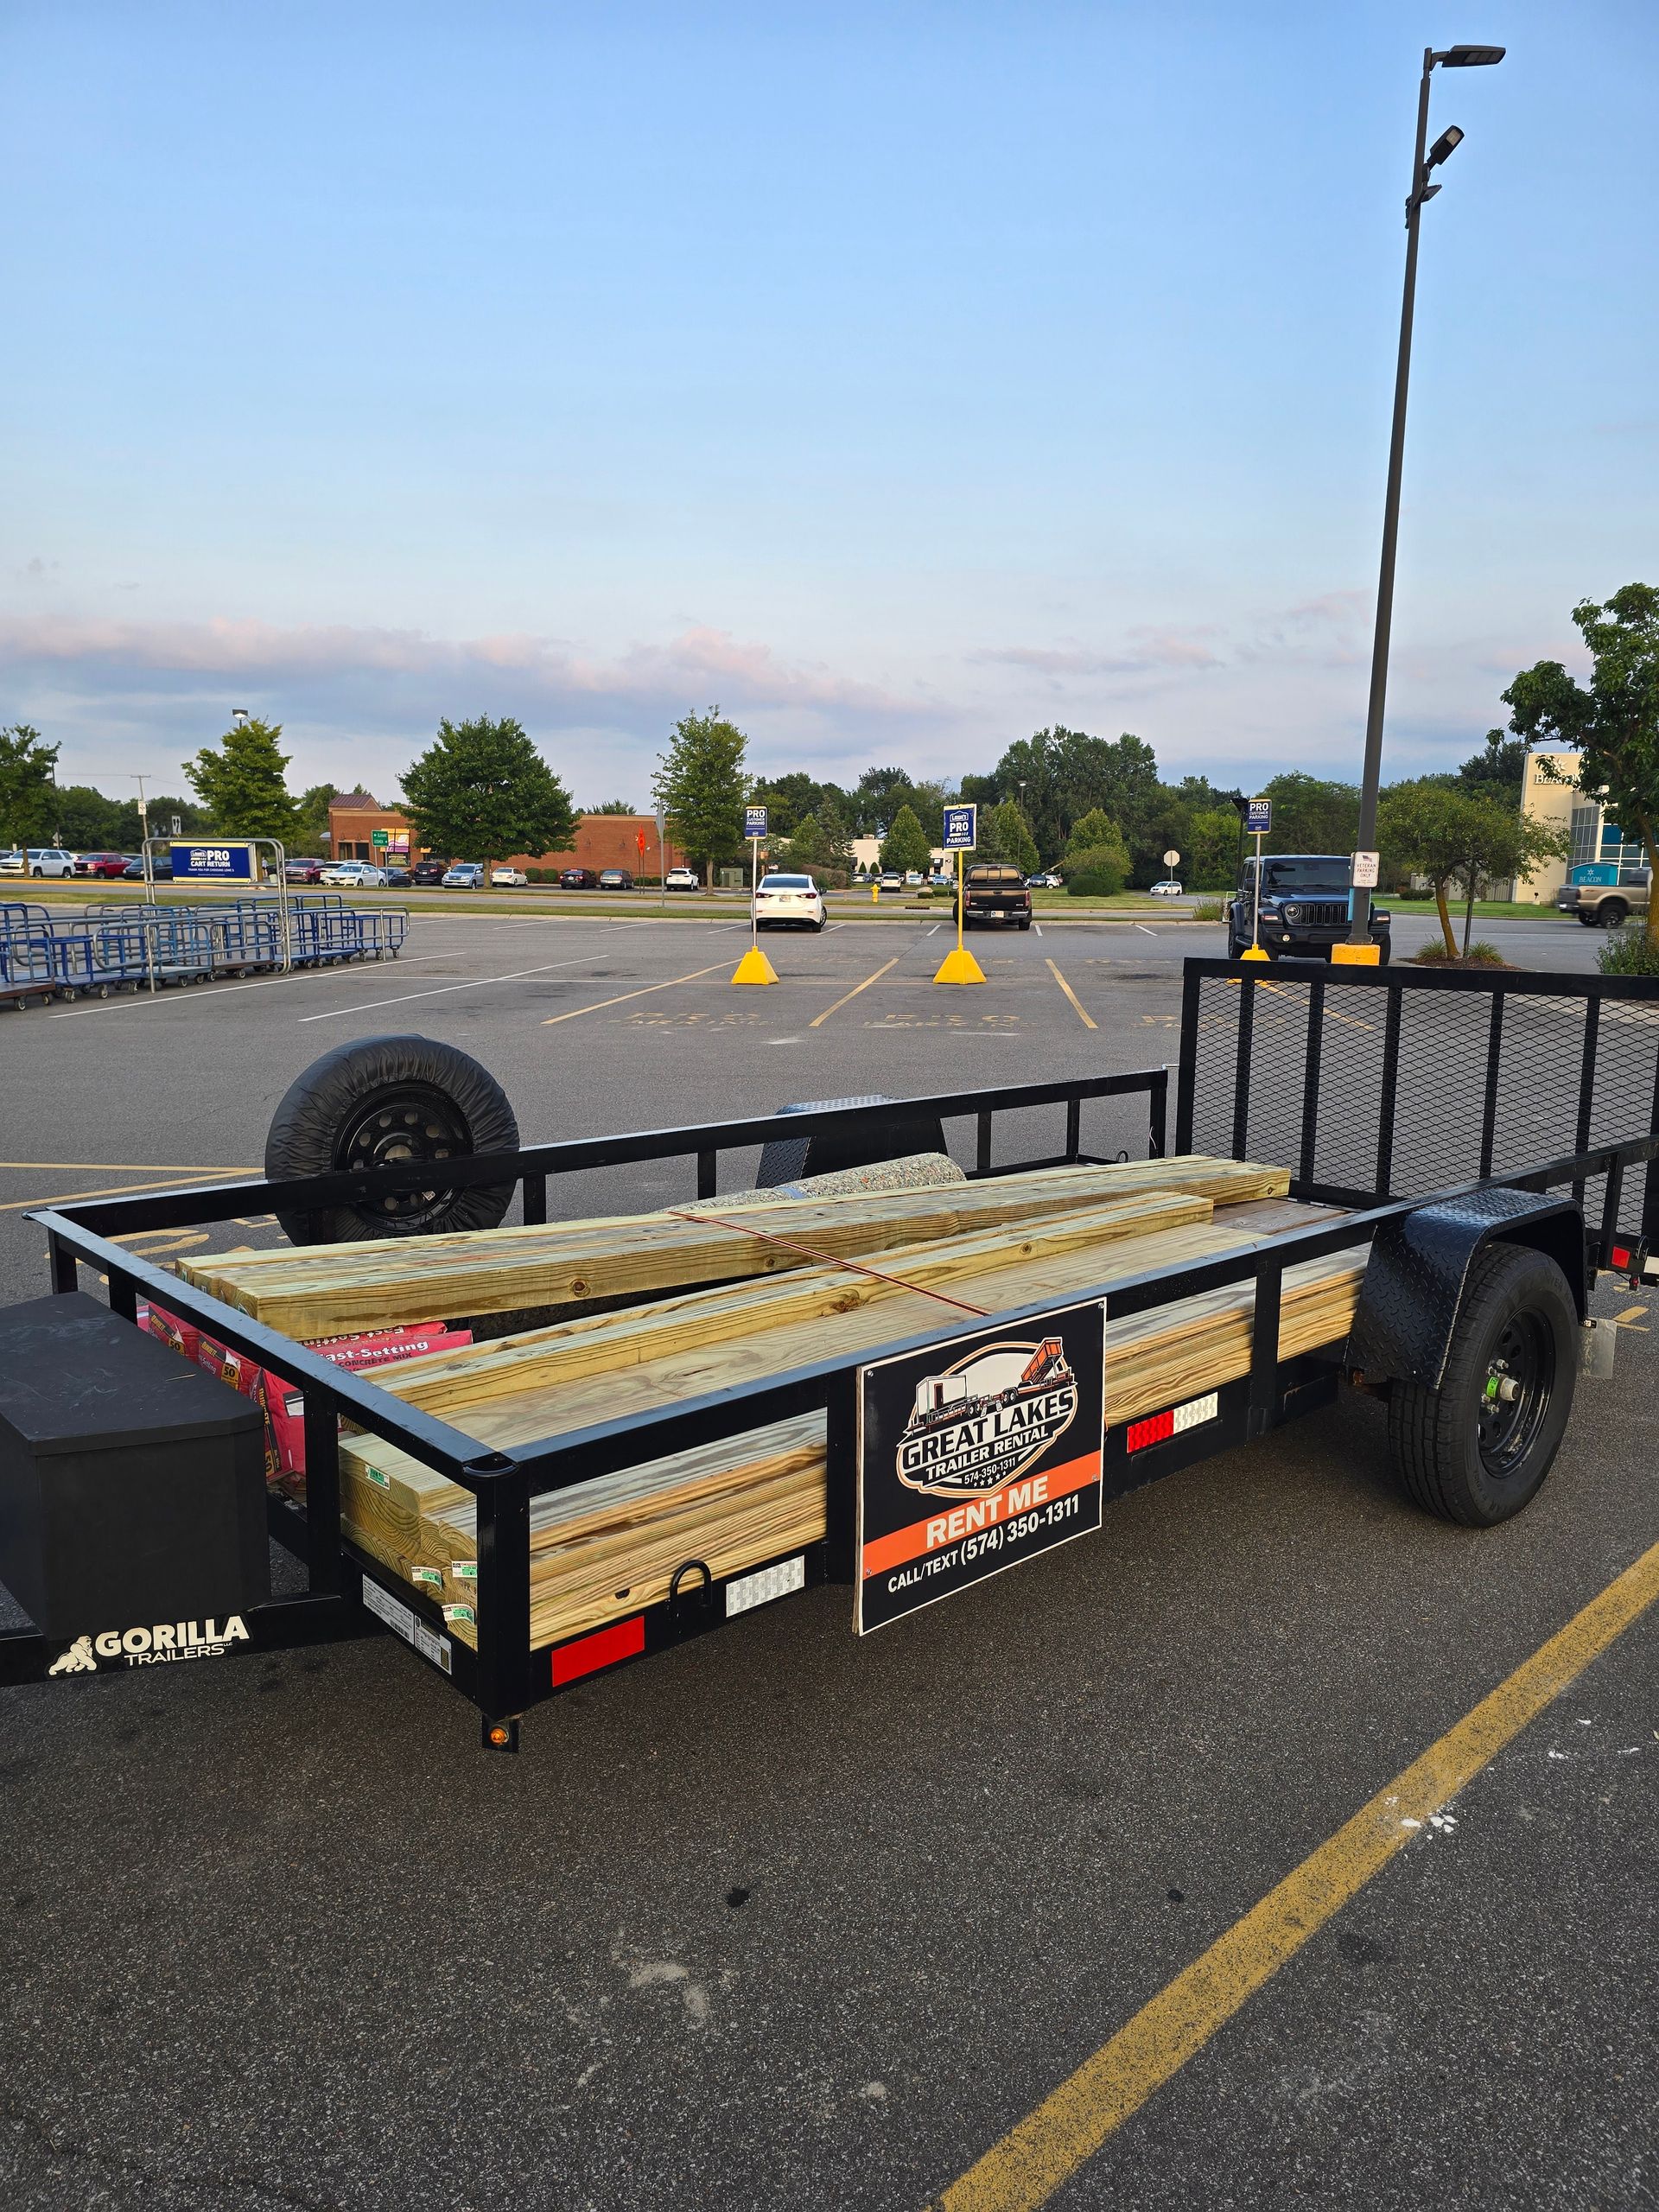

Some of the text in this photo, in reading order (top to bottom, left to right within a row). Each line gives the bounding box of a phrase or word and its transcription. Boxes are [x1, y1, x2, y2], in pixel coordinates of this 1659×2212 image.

[1249, 803, 1268, 811] PRO
[950, 822, 969, 832] PRO
[207, 850, 230, 861] PRO
[223, 1366, 236, 1377] 50
[338, 1352, 413, 1368] CONCRETE MIX
[903, 1389, 1074, 1468] GREAT LAKES
[925, 1426, 1049, 1481] TRAILER RENTAL
[964, 1457, 1016, 1484] 574-350-1311
[926, 1475, 1049, 1548] RENT ME
[887, 1494, 1079, 1593] CALL/TEXT (574) 350-1311
[95, 1615, 250, 1657] GORILLA
[124, 1643, 226, 1667] TRAILERS
